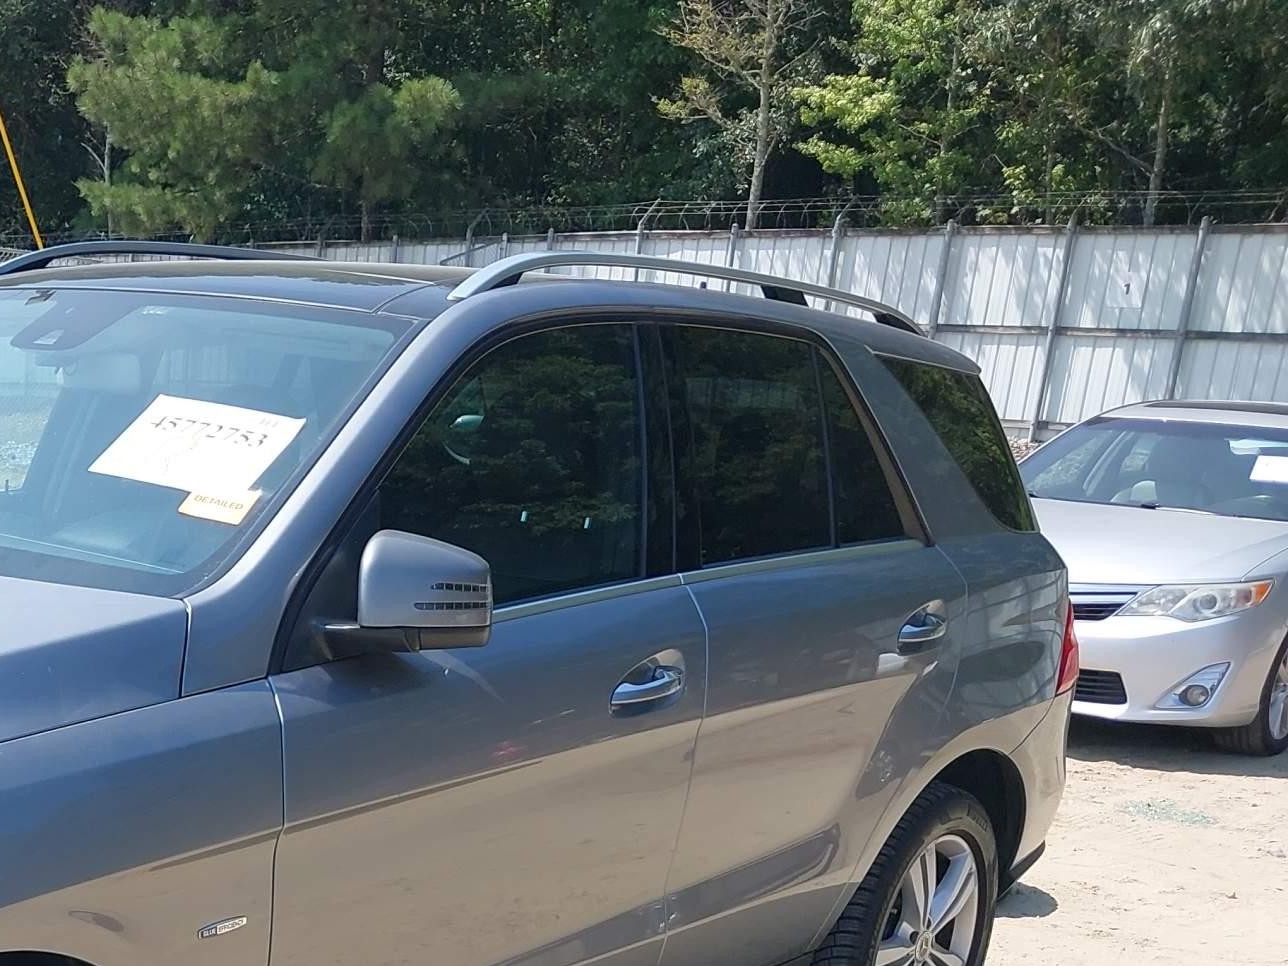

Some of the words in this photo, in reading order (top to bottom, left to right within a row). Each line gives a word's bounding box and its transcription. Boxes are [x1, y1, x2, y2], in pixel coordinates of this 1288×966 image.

[1124, 283, 1131, 295] 1
[151, 416, 268, 448] 45772753
[193, 494, 244, 511] DETAILED
